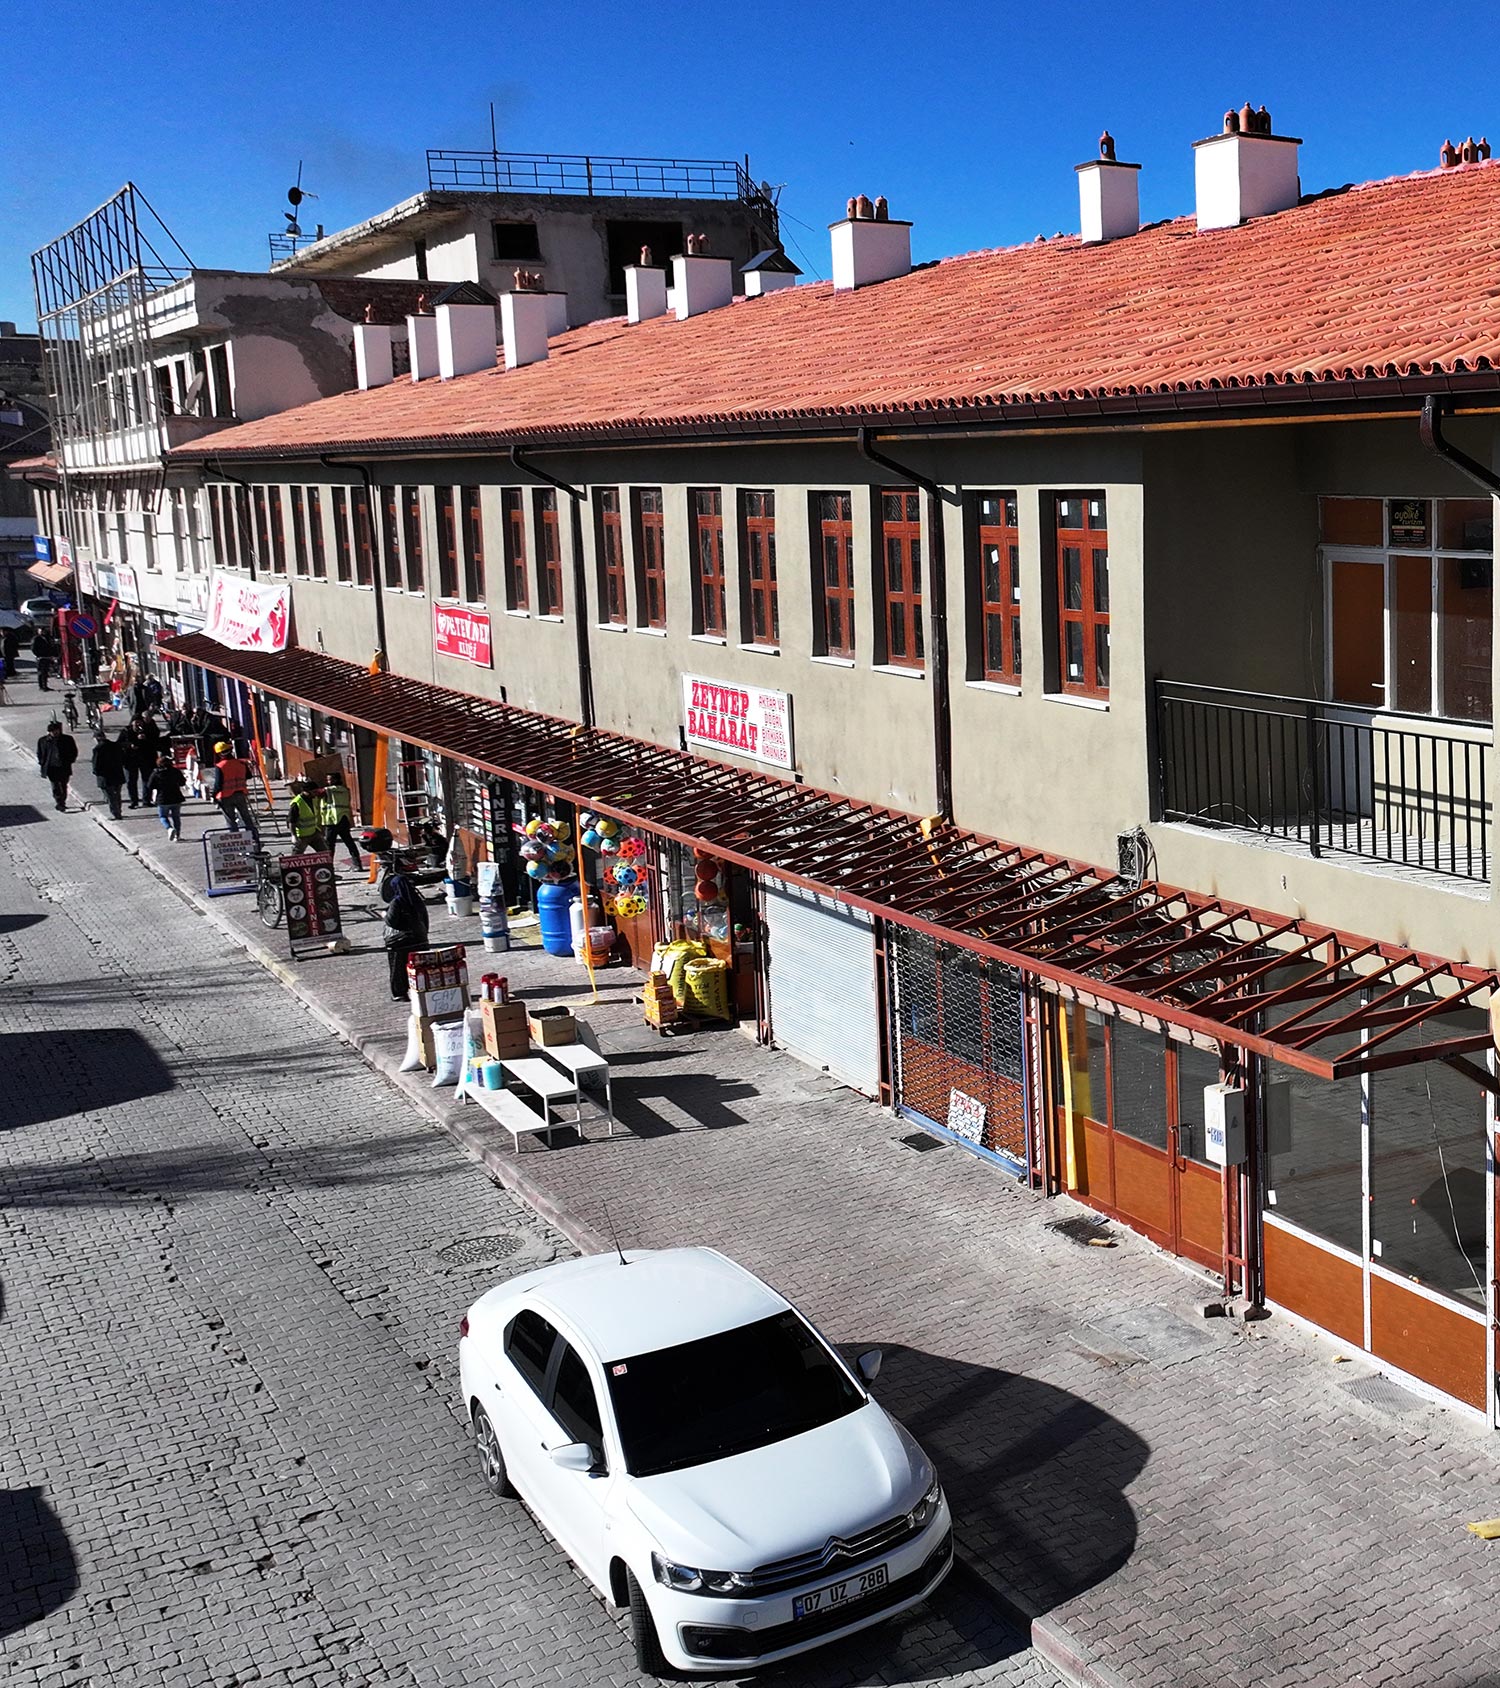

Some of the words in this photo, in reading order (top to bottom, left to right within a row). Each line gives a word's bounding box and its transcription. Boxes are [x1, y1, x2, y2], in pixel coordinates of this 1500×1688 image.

[692, 680, 749, 720] ZEYNEP
[688, 707, 758, 753] BAHARAT
[804, 1593, 821, 1612] 07
[830, 1584, 848, 1602] UZ
[859, 1569, 884, 1592] 288
